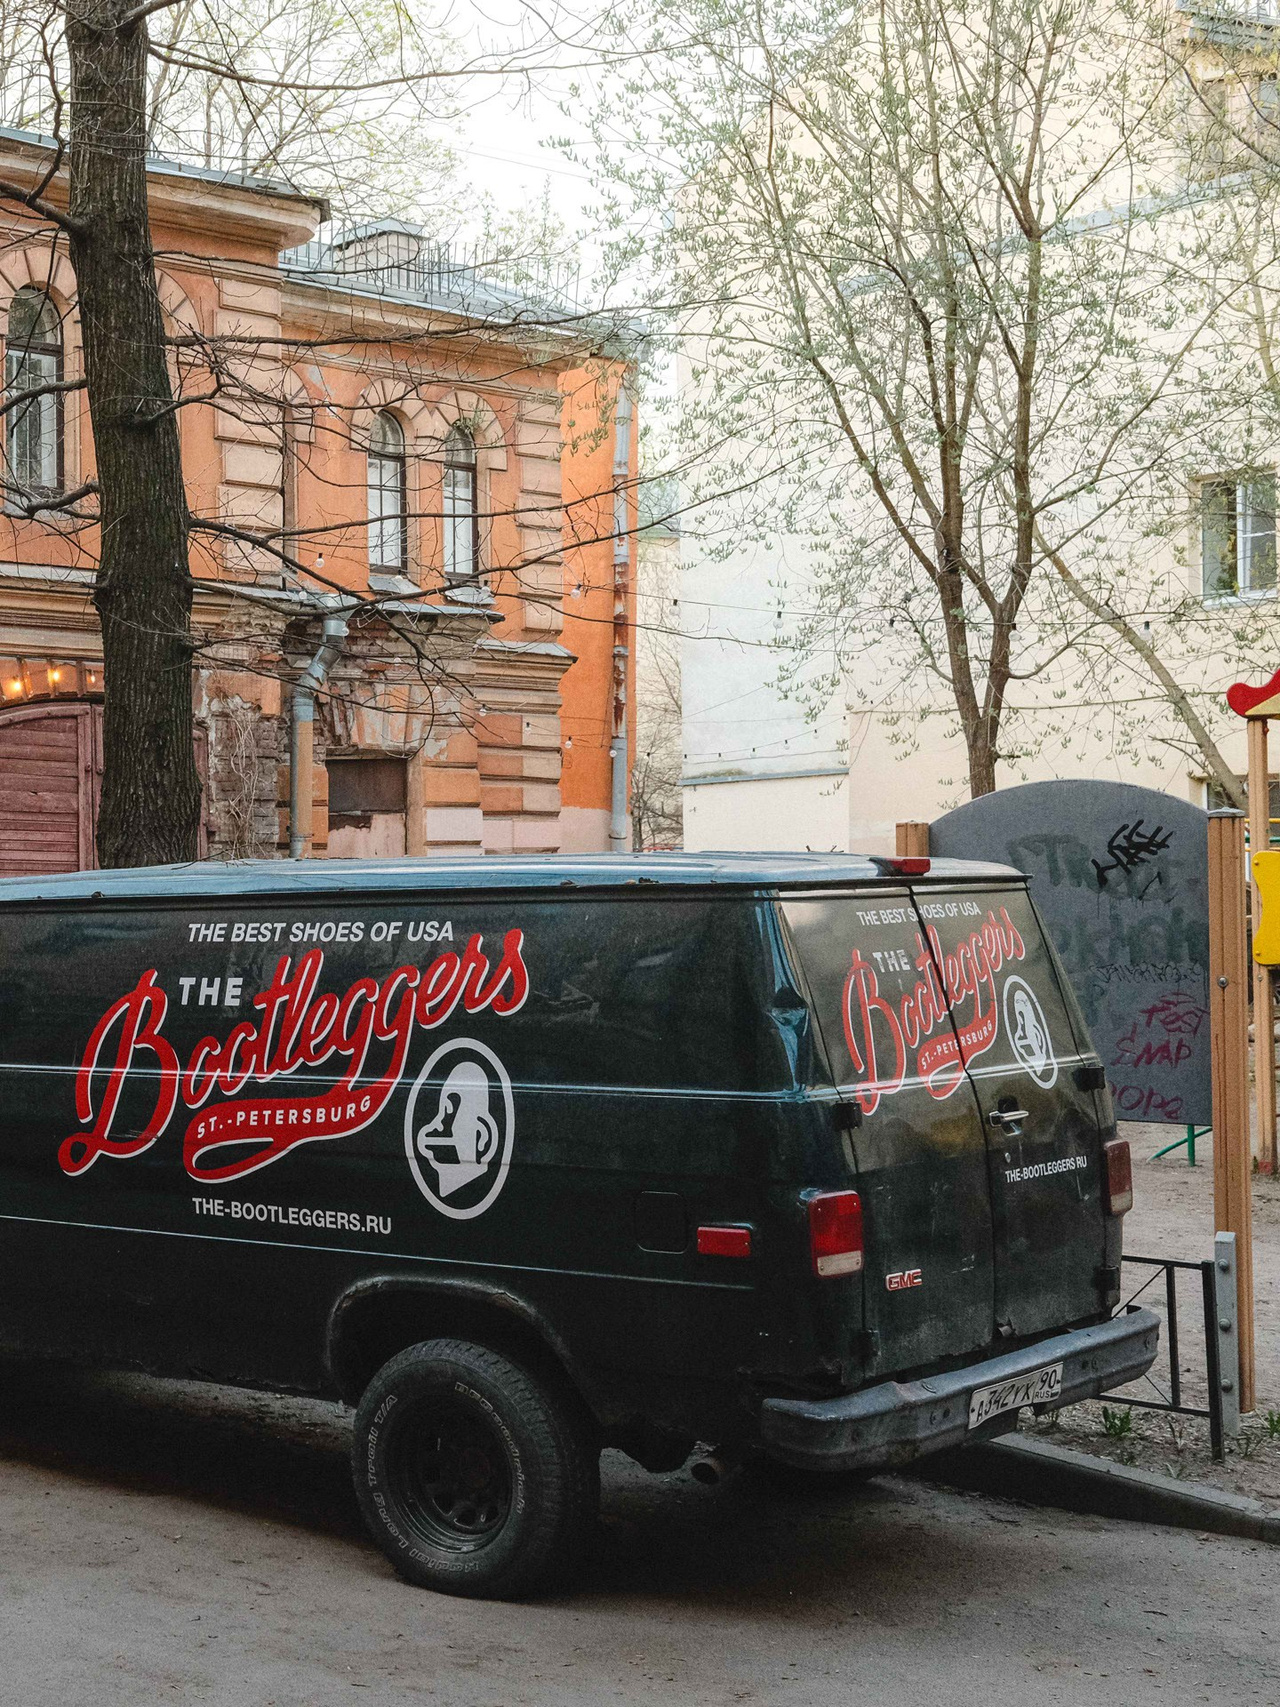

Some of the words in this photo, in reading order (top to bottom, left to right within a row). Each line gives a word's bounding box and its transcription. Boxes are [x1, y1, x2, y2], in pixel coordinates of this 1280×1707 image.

[856, 911, 880, 926] THE
[879, 908, 907, 924] BEST
[907, 904, 945, 921] SHOES
[945, 903, 959, 917] OF
[959, 901, 981, 916] USA
[188, 923, 227, 942] THE
[231, 923, 286, 942] BEST
[289, 921, 365, 942] SHOES
[370, 922, 402, 942] OF
[407, 921, 454, 941] USA
[872, 949, 910, 973] THE
[179, 976, 243, 1006] THE
[842, 906, 1026, 1116] Bootleggers
[58, 928, 529, 1178] Bootleggers
[196, 1094, 372, 1139] ST.-PETERSBURG
[192, 1197, 392, 1236] THE-BOOTLEGGERS.RU
[885, 1269, 922, 1291] GMC
[1039, 1369, 1057, 1390] 90
[1035, 1390, 1050, 1399] RUS
